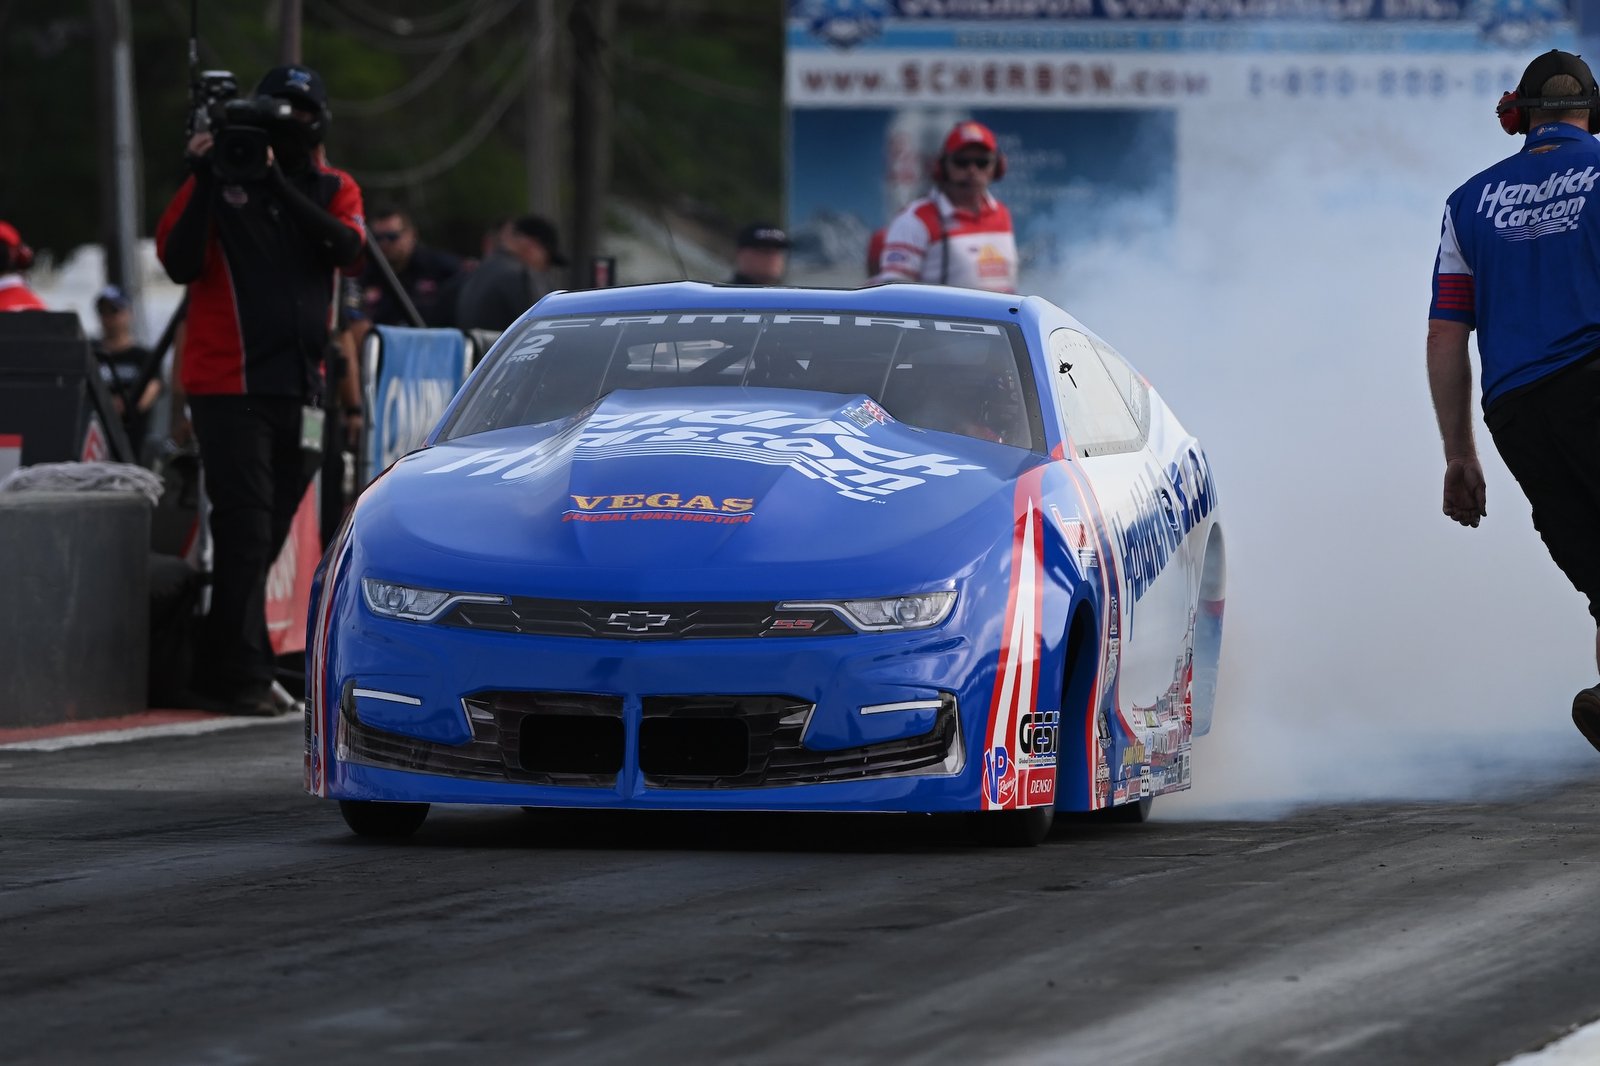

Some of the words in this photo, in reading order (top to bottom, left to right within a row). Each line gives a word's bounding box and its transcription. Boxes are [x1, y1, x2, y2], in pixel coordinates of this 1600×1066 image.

[1476, 166, 1600, 218] Hendrick
[1494, 196, 1586, 228] Cars.com
[529, 313, 1002, 335] CAMARO
[511, 333, 555, 356] 2
[507, 353, 540, 364] PRO
[569, 493, 754, 512] VEGAS
[561, 513, 628, 522] GENERAL
[630, 512, 753, 525] CONSTRUCTION
[769, 618, 815, 630] SS
[984, 745, 1009, 804] VP
[1030, 778, 1053, 794] DENSO
